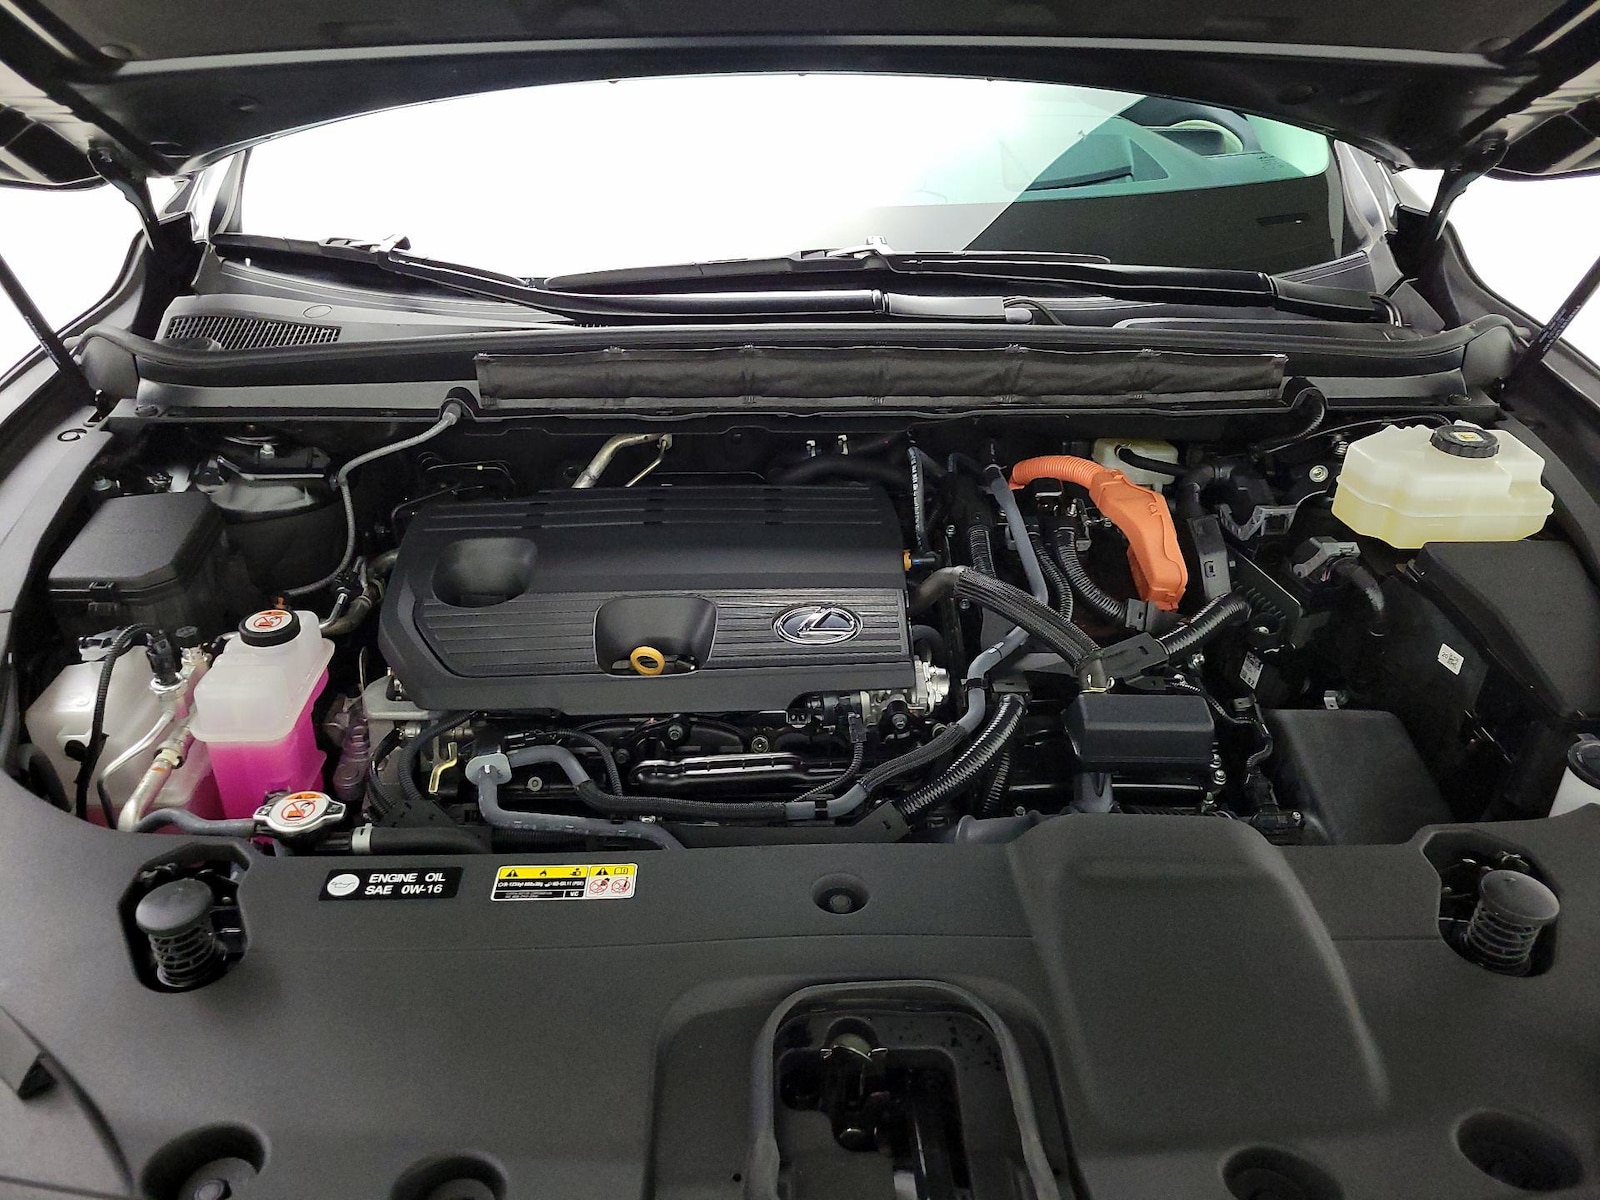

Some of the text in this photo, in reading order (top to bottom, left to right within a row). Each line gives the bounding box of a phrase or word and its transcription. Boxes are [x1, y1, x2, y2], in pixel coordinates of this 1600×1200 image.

[368, 872, 446, 883] ENGINE OIL
[364, 884, 443, 895] SAE 0W-16
